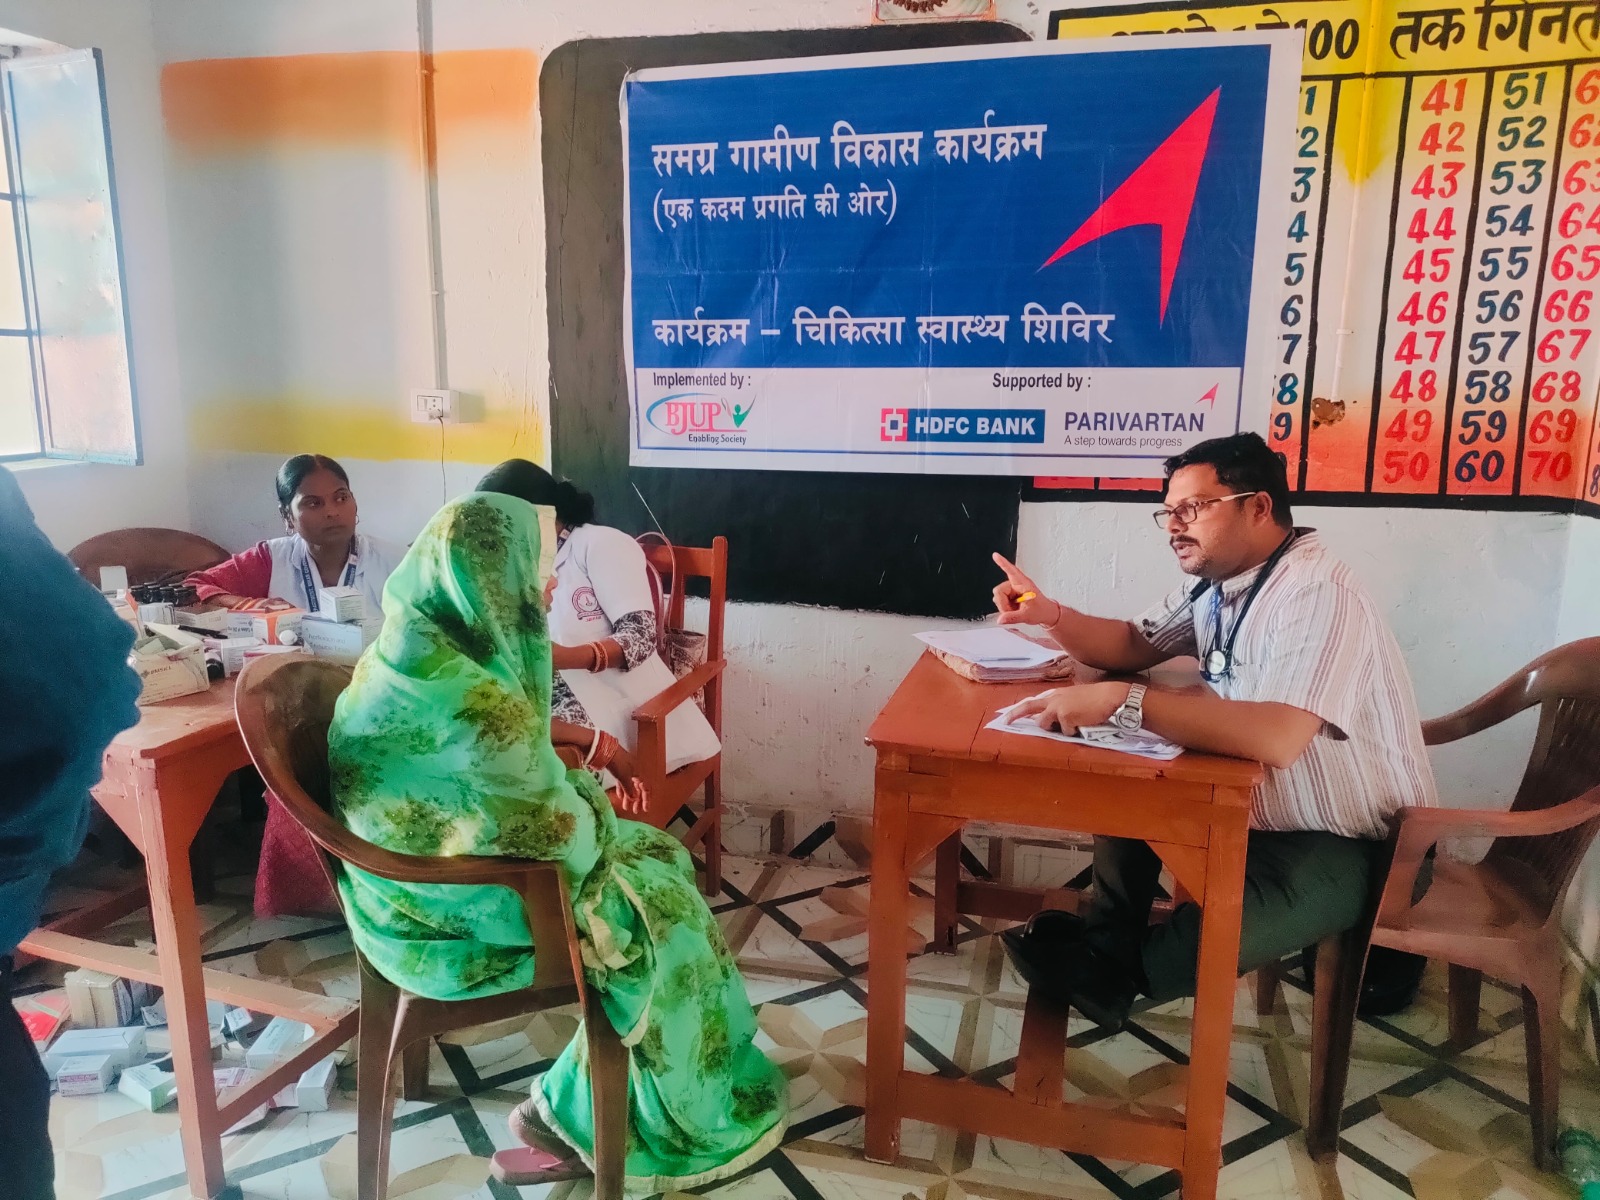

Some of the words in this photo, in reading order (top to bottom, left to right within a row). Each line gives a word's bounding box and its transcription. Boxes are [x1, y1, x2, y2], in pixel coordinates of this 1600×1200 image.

[1390, 8, 1465, 59] तक
[1420, 78, 1468, 116] 41
[1503, 71, 1547, 110] 51
[652, 142, 718, 177] समग्र
[728, 124, 820, 173] गामीण
[830, 120, 923, 170] विकास
[934, 109, 1048, 165] कार्यक्रम
[1418, 122, 1465, 156] 42
[1497, 115, 1547, 151] 52
[1411, 162, 1466, 200] 43
[1490, 159, 1546, 195] 53
[653, 188, 694, 232] (एक
[700, 197, 746, 222] कदम
[752, 184, 807, 220] प्रगति
[814, 183, 840, 218] की
[847, 179, 897, 225] ओर)
[1485, 203, 1534, 238] 54
[1558, 202, 1600, 239] 64
[1406, 207, 1457, 244] 44
[1402, 247, 1455, 285] 45
[1478, 246, 1533, 282] 55
[1551, 244, 1600, 282] 65
[1397, 291, 1449, 326] 46
[1475, 289, 1523, 324] 56
[1543, 289, 1593, 323] 66
[652, 306, 750, 346] कार्यक्रम
[792, 305, 906, 346] चिकित्सा
[916, 314, 1010, 345] स्वास्थ्य
[1021, 302, 1116, 344] शिविर
[1394, 331, 1446, 365] 47
[1468, 331, 1521, 365] 57
[1537, 329, 1592, 363] 67
[653, 372, 727, 389] Implemented
[730, 372, 744, 389] by
[992, 372, 1062, 391] Supported
[1066, 373, 1083, 392] by
[1389, 369, 1437, 404] 48
[1464, 370, 1512, 404] 58
[1531, 370, 1582, 403] 68
[665, 402, 722, 435] BJUP
[915, 416, 970, 435] HDFC
[976, 417, 1036, 435] BANK
[1064, 411, 1205, 432] PARIVARTAN
[1384, 409, 1433, 443] 49
[1458, 410, 1507, 445] 59
[1528, 408, 1577, 444] 69
[688, 433, 720, 445] Enabling
[721, 433, 747, 445] Society
[1064, 434, 1072, 446] A
[1074, 436, 1096, 448] step
[1098, 435, 1137, 447] towards
[1139, 436, 1183, 449] progress
[1383, 450, 1430, 484] 50
[1454, 450, 1505, 482] 60
[1527, 451, 1572, 481] 70
